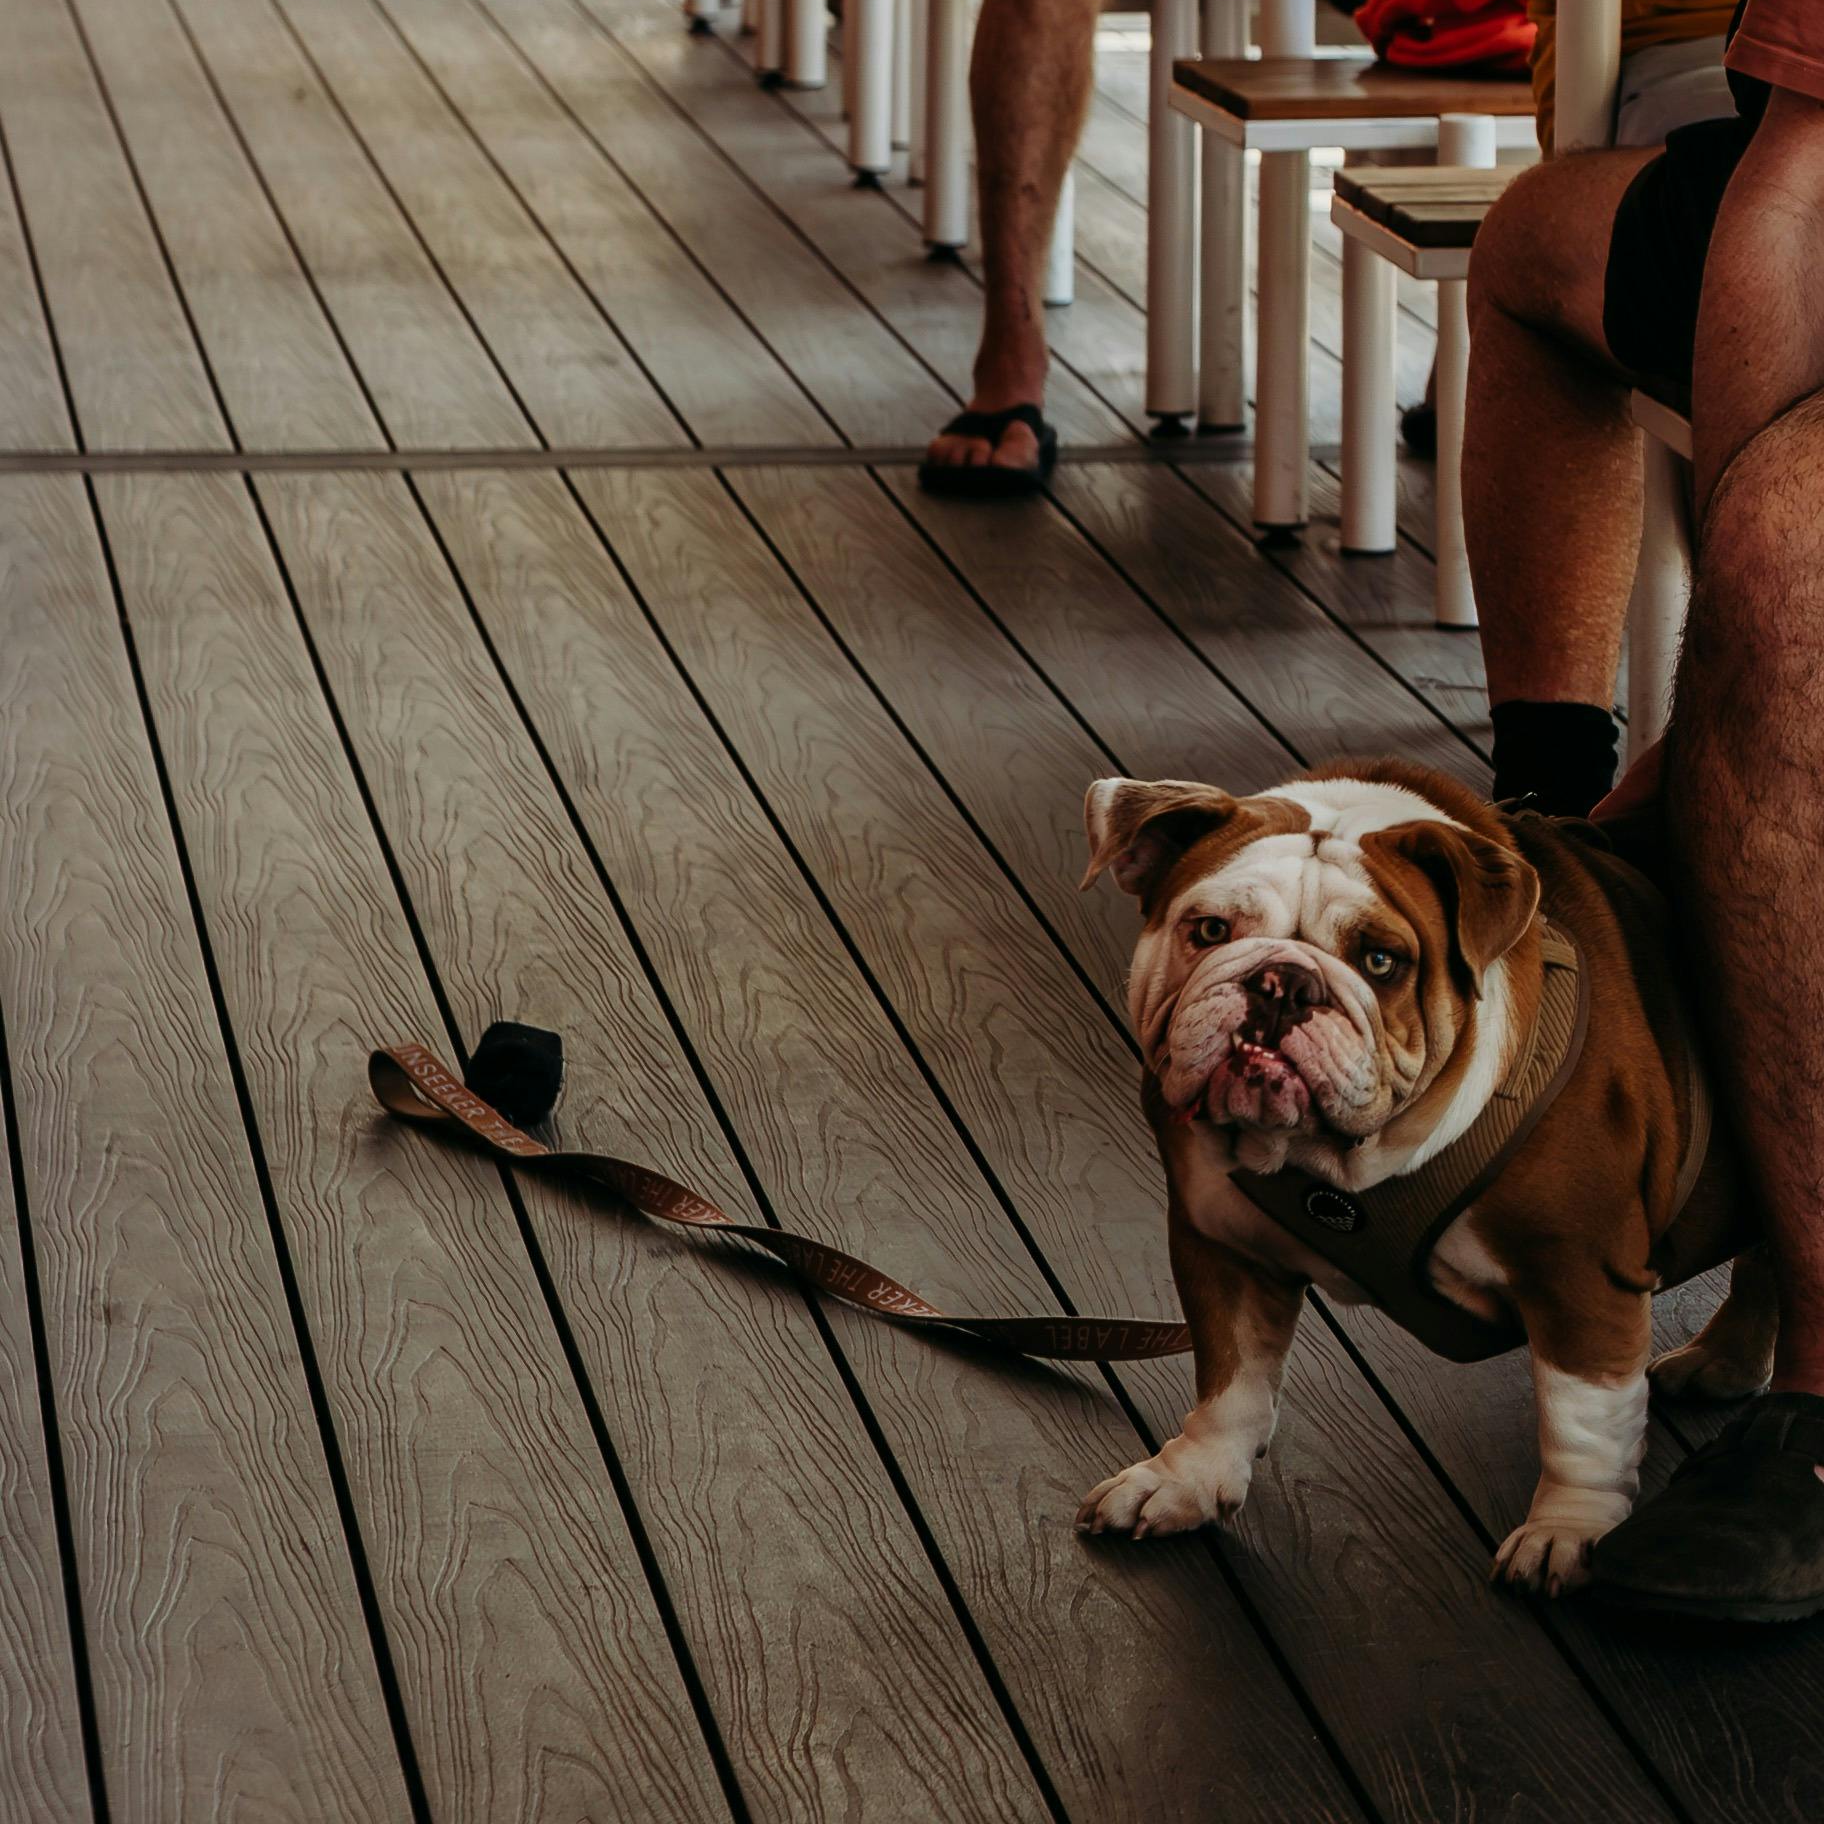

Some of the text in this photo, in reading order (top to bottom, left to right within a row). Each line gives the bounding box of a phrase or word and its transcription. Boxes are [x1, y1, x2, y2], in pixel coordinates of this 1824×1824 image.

[827, 1259, 868, 1293] THE
[1045, 1325, 1189, 1351] THE LABEL
